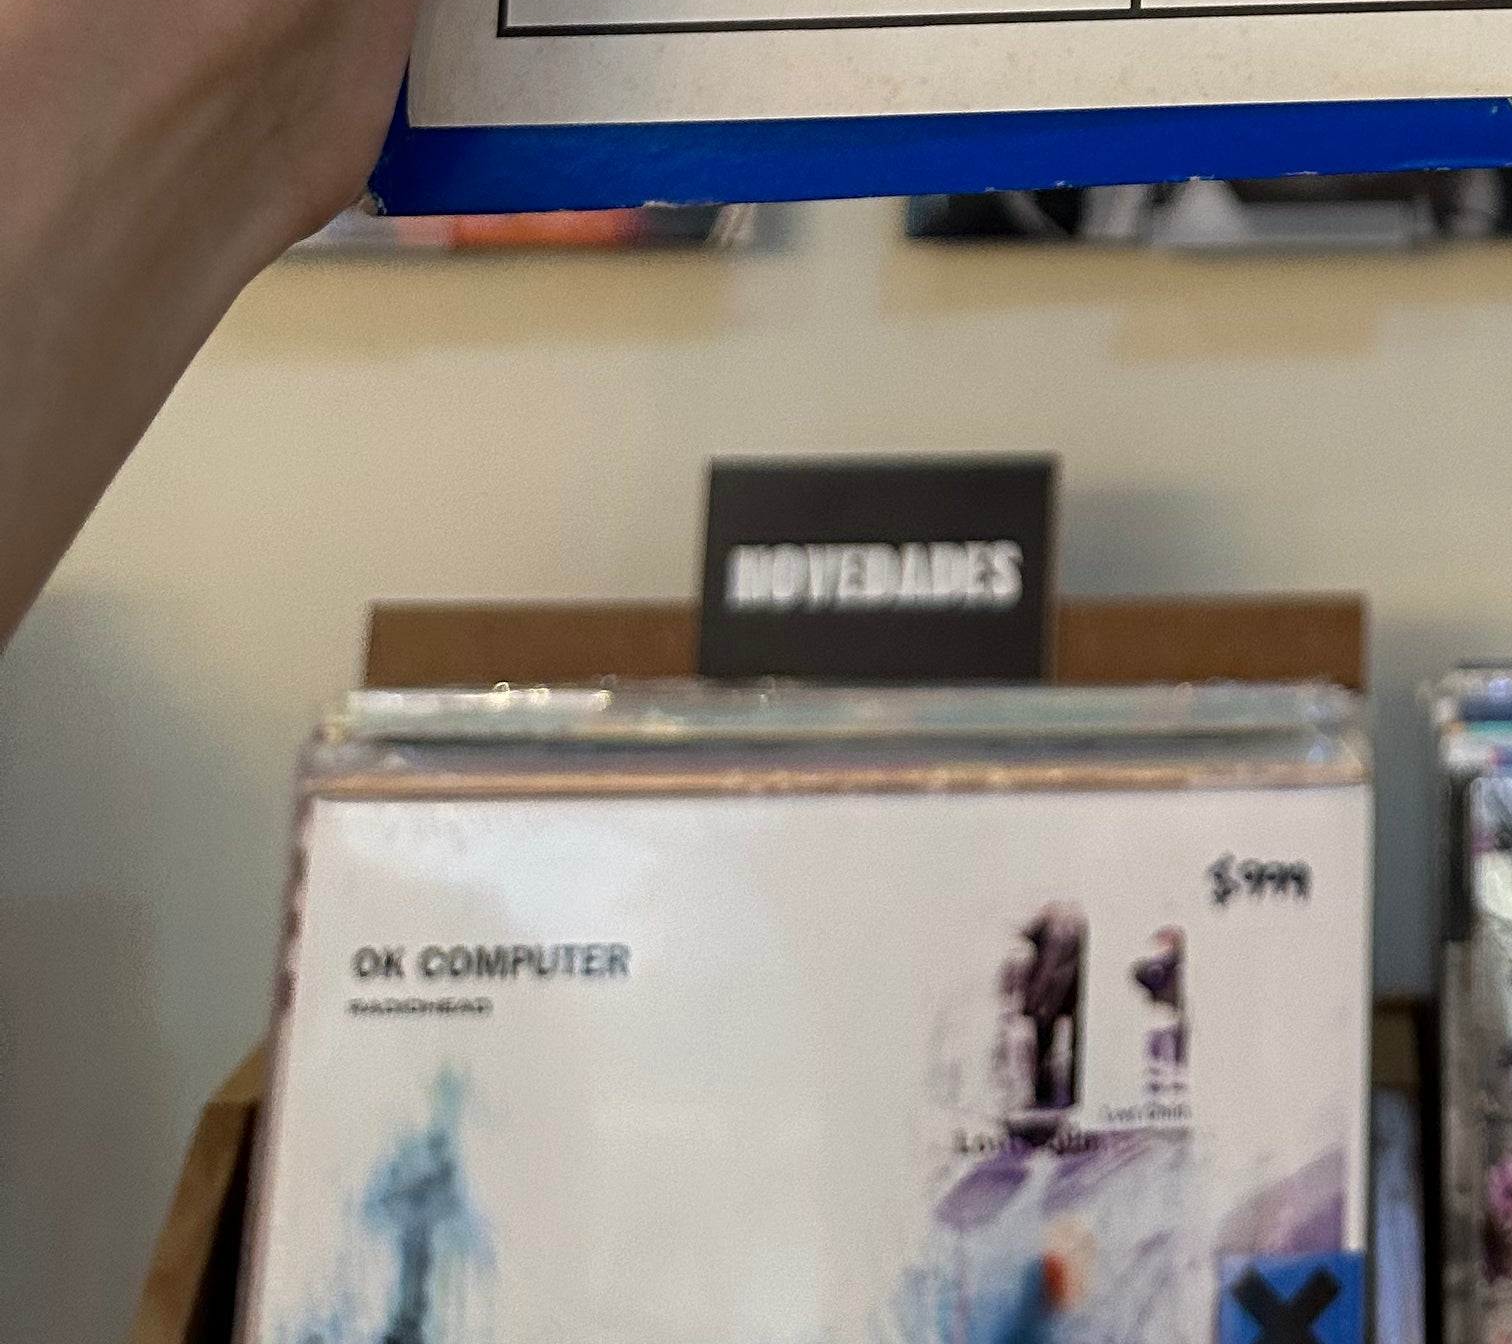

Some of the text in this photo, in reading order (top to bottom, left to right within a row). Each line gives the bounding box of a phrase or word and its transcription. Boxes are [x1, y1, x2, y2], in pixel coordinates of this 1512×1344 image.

[724, 539, 1024, 611] NOVEDADES
[351, 941, 630, 982] OK COMPUTER
